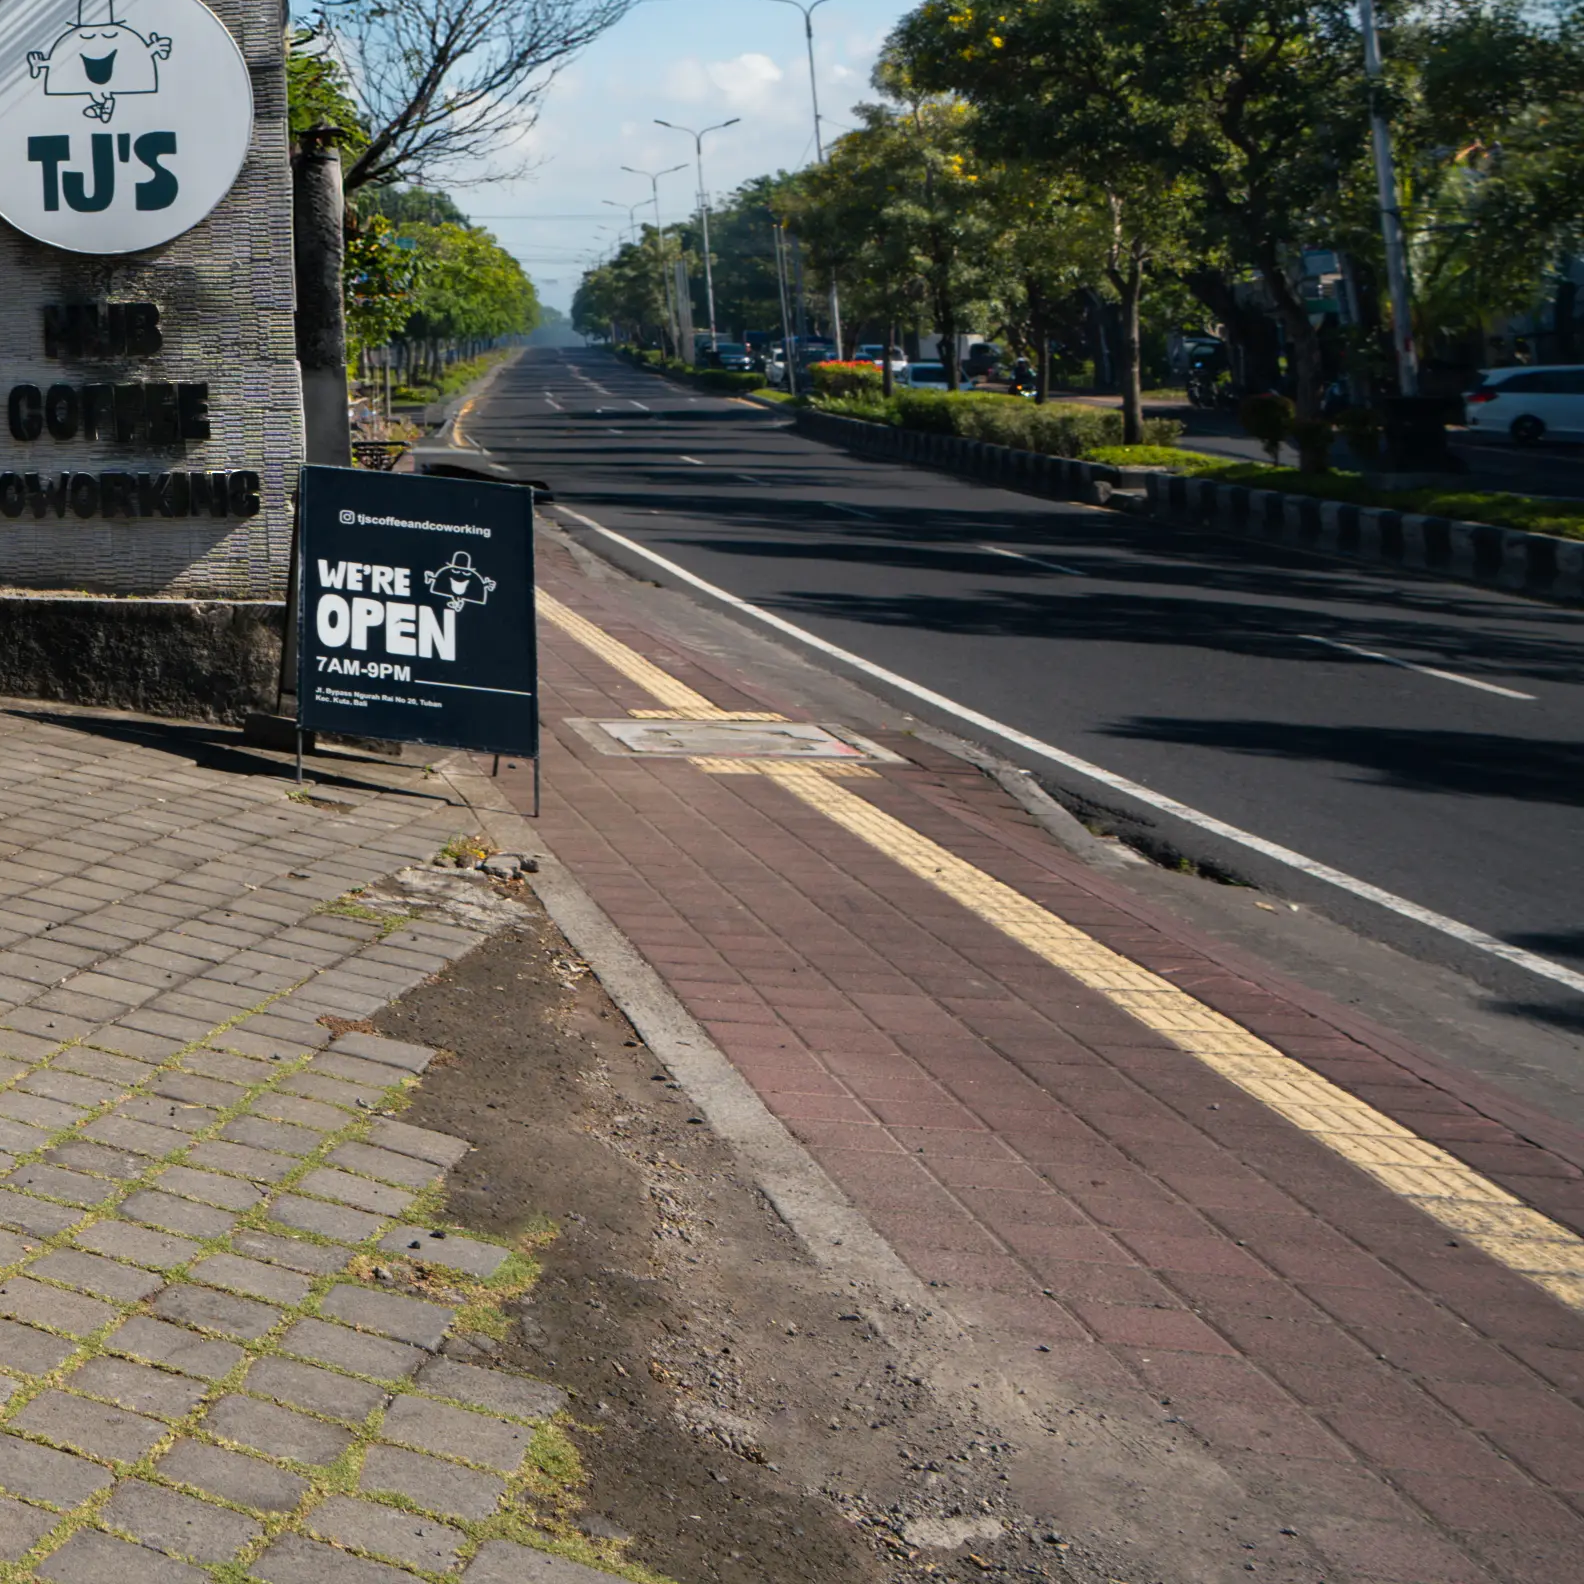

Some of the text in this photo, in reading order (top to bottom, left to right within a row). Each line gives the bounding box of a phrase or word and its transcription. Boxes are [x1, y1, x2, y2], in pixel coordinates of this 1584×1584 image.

[27, 131, 180, 214] TJ'S
[8, 382, 212, 443] COFFEE
[357, 513, 492, 539] tjscoffeeandcoworking
[316, 593, 457, 662] OPEN
[316, 656, 412, 682] 7AM-9PM
